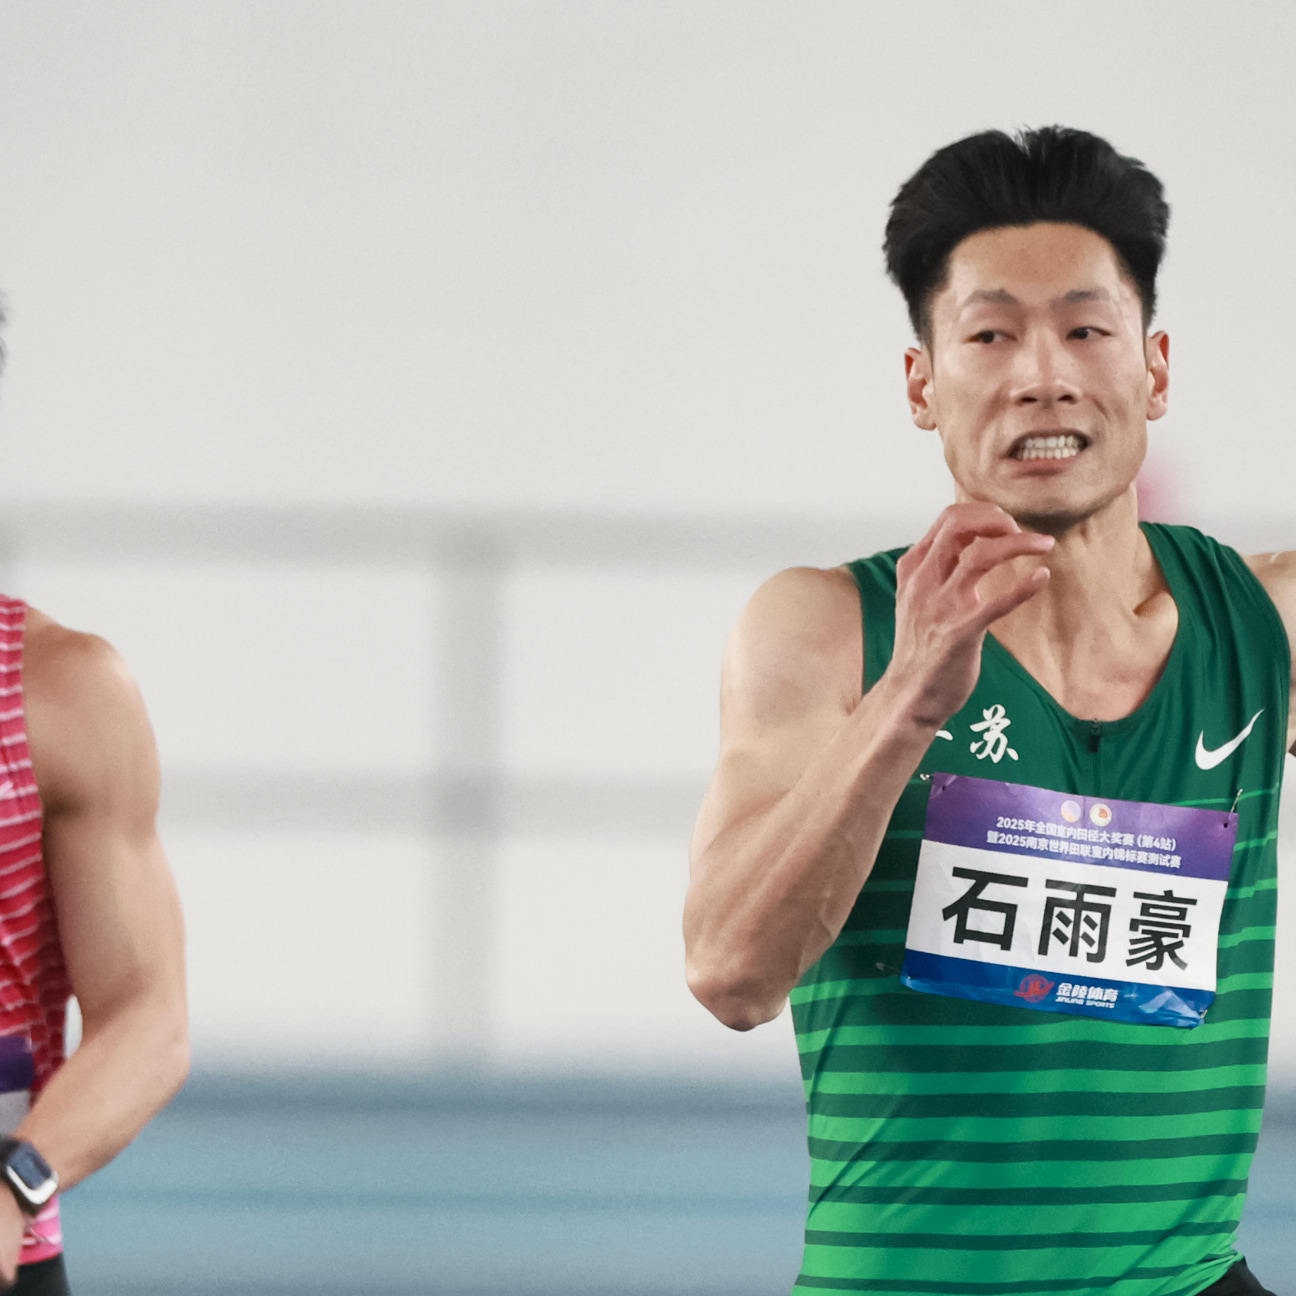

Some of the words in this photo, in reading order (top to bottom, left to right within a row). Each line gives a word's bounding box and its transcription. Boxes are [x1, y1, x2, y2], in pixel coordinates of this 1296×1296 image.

[935, 704, 1019, 764] 苏
[942, 866, 1198, 972] 石雨豪
